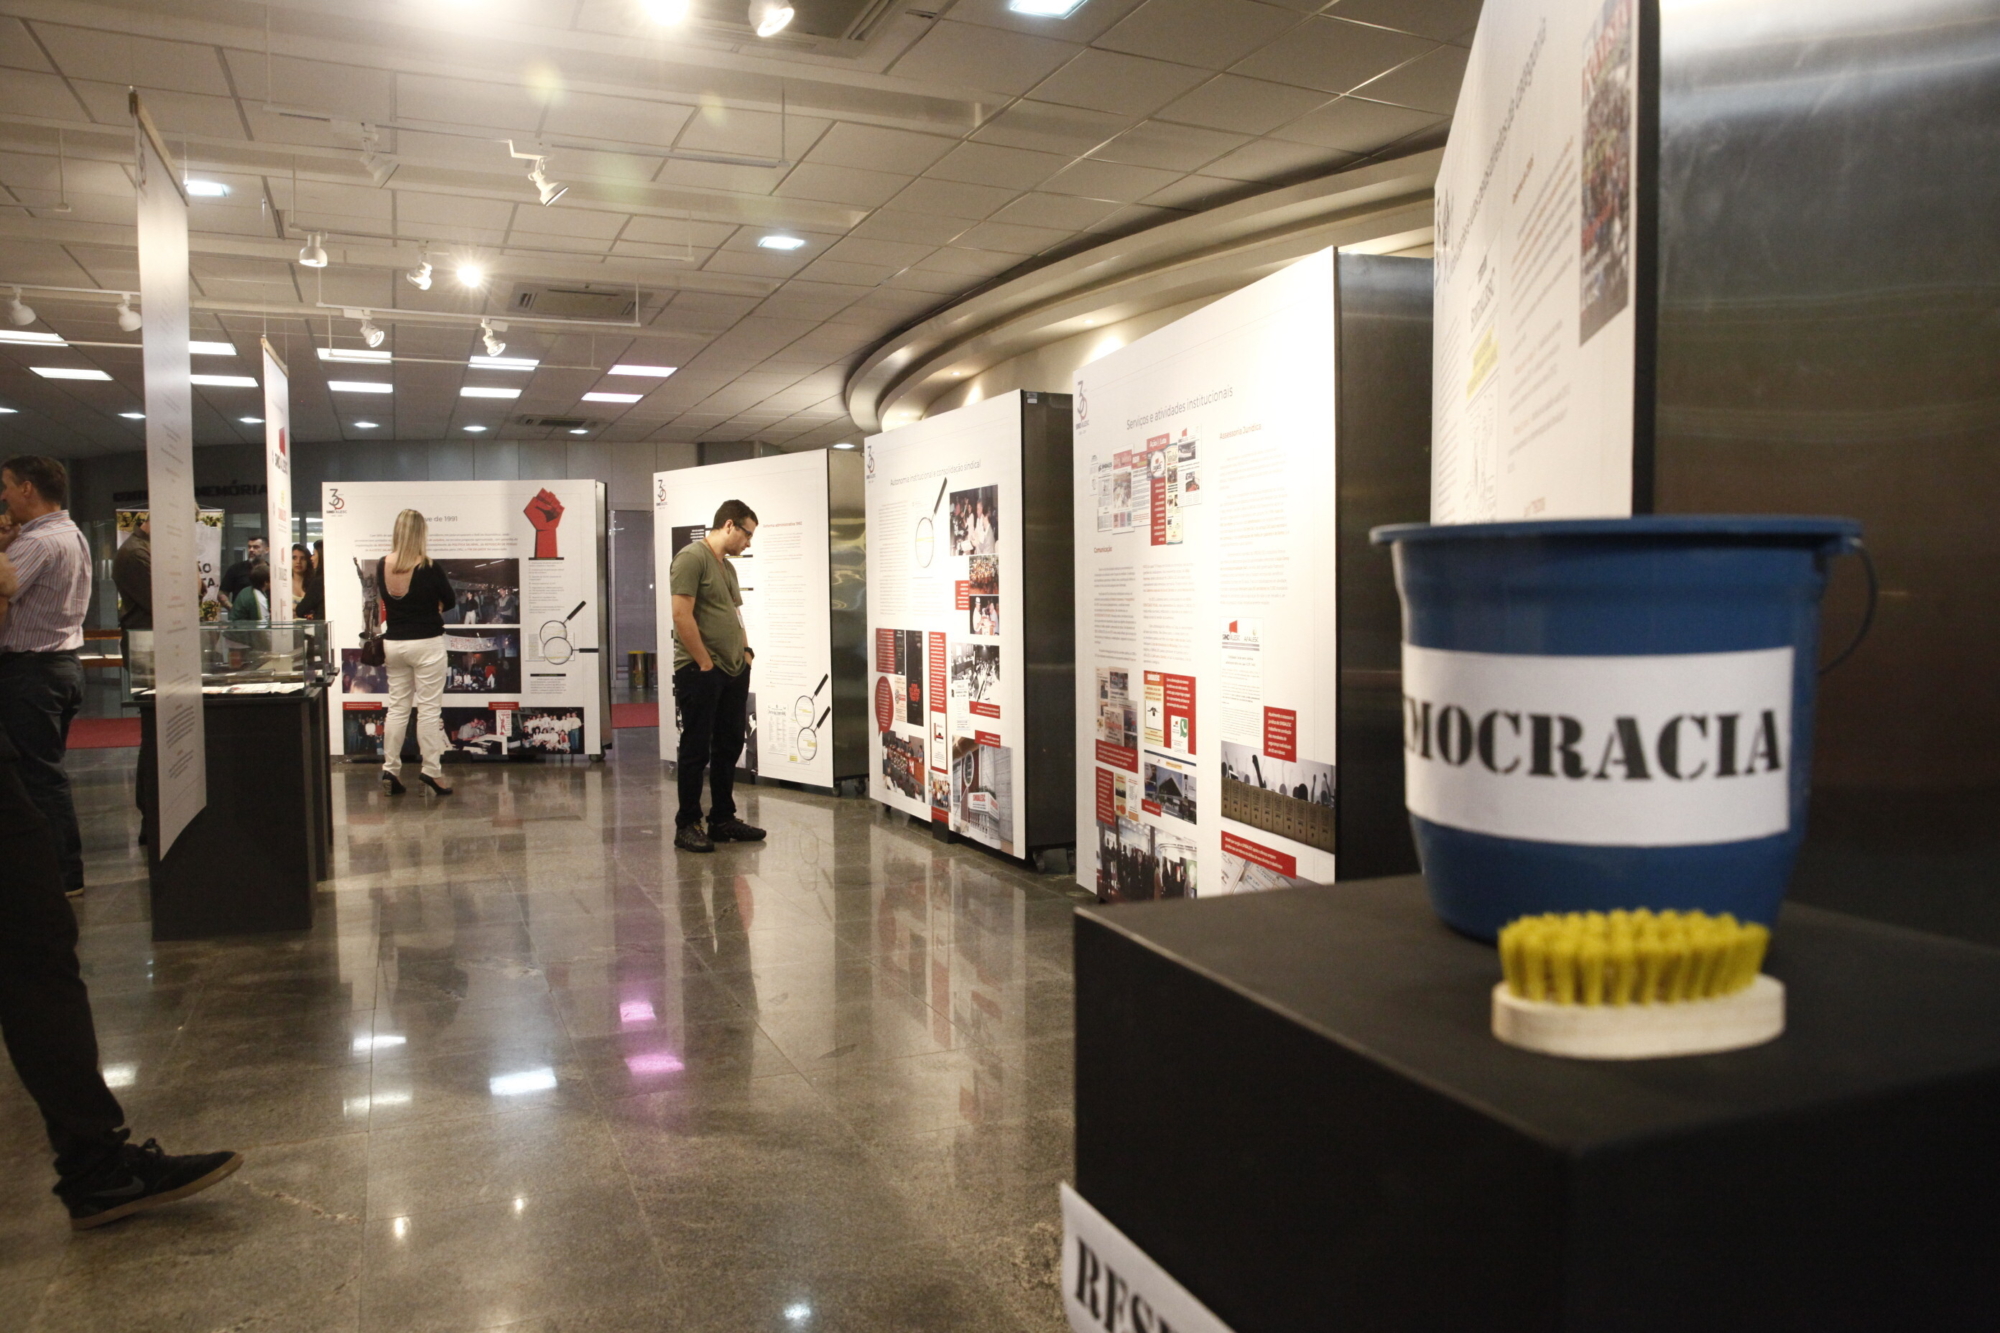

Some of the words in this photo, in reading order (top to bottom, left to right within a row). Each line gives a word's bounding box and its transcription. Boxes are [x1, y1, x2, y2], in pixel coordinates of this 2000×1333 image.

[1126, 411, 1149, 430] Serviços
[1149, 413, 1154, 422] e
[1154, 401, 1186, 422] atividades
[1186, 386, 1233, 413] institucionais
[963, 458, 981, 471] sindical
